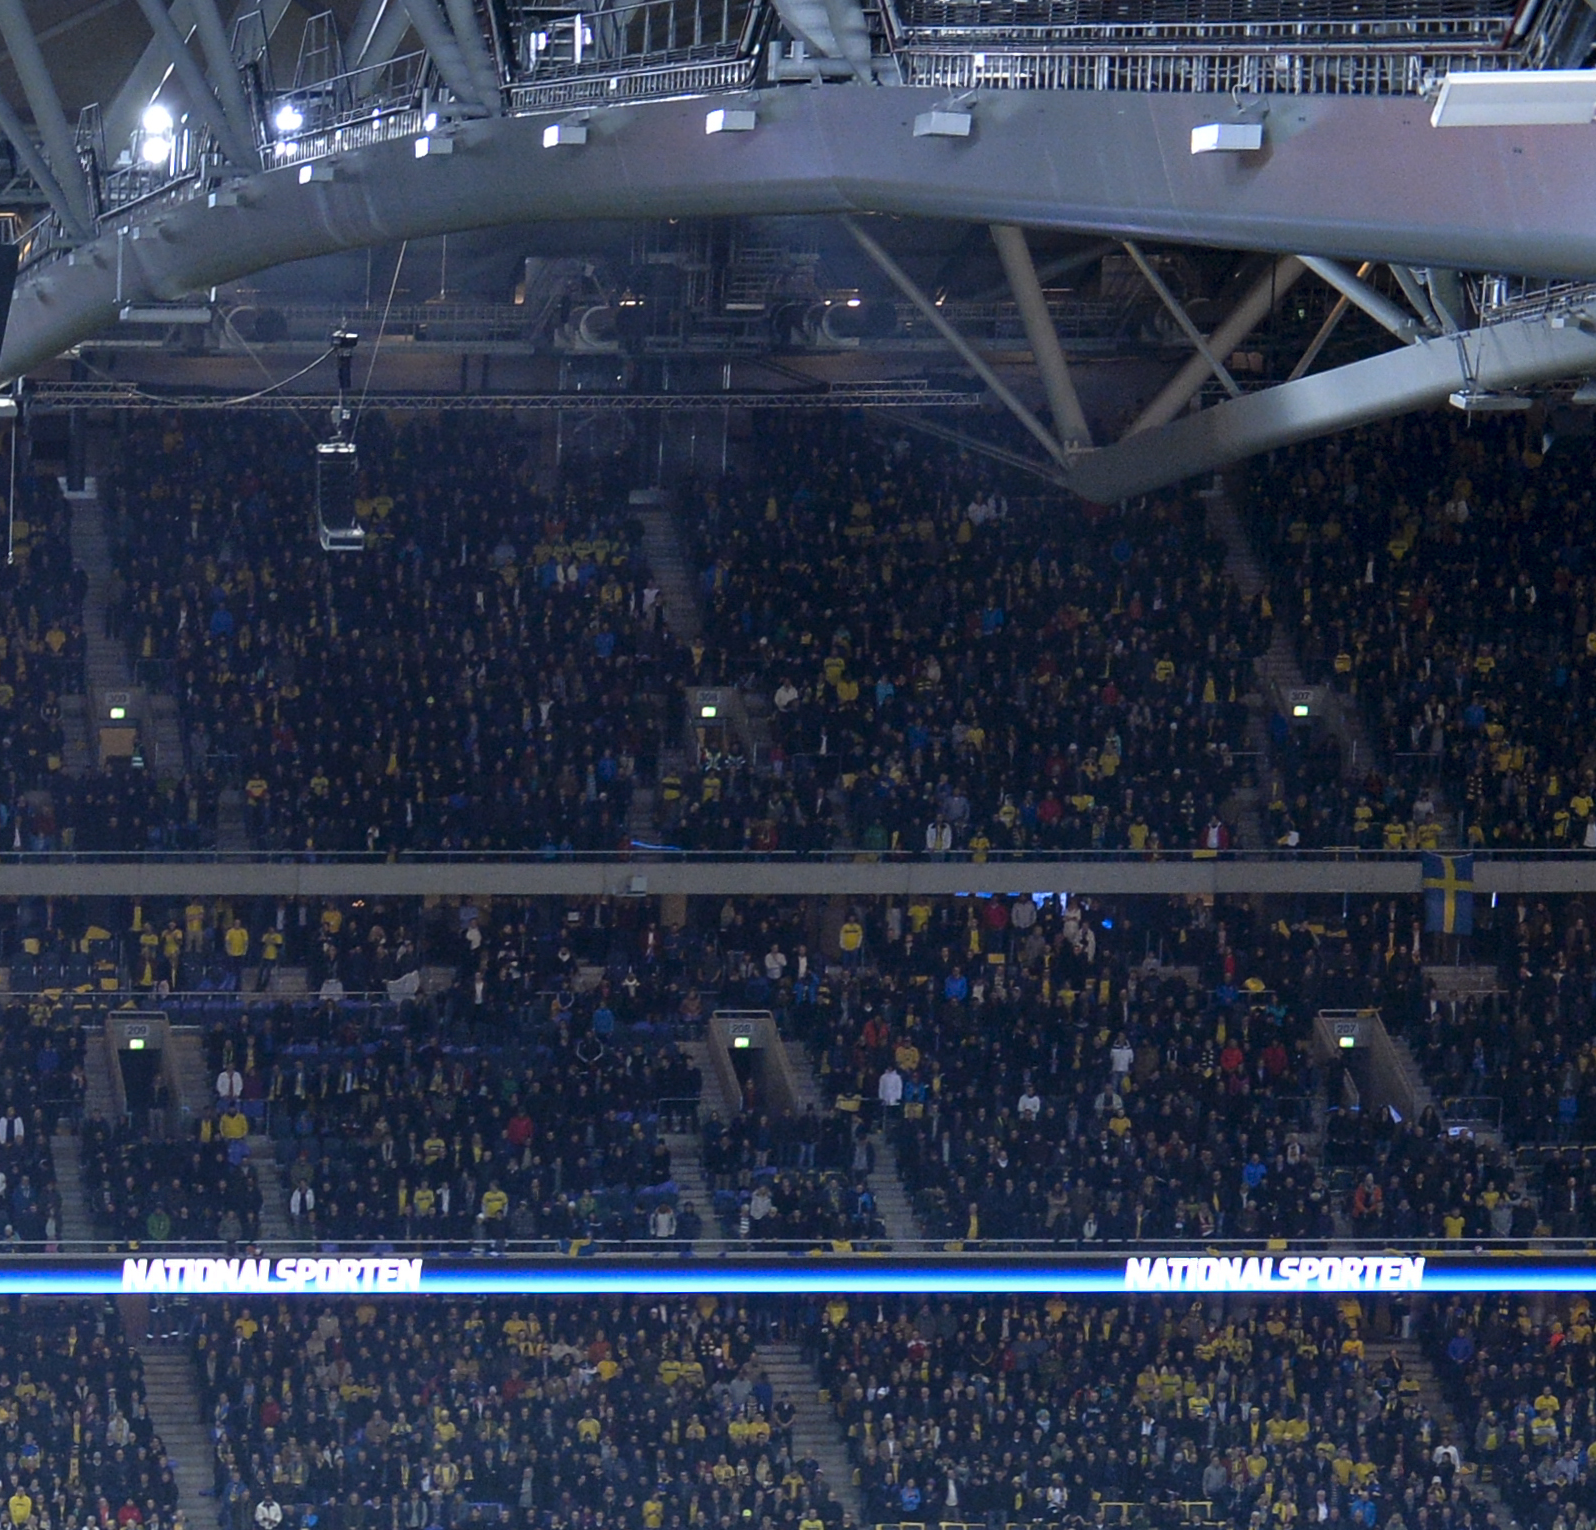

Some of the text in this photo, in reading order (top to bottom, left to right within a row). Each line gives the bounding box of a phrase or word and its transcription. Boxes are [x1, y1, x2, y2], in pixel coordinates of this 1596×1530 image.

[128, 1025, 146, 1035] 209
[732, 1024, 750, 1034] 208
[1337, 1024, 1355, 1034] 207
[122, 1259, 423, 1292] NATIONALSPORTEN
[1125, 1258, 1424, 1291] NATIONALSPORTEN
